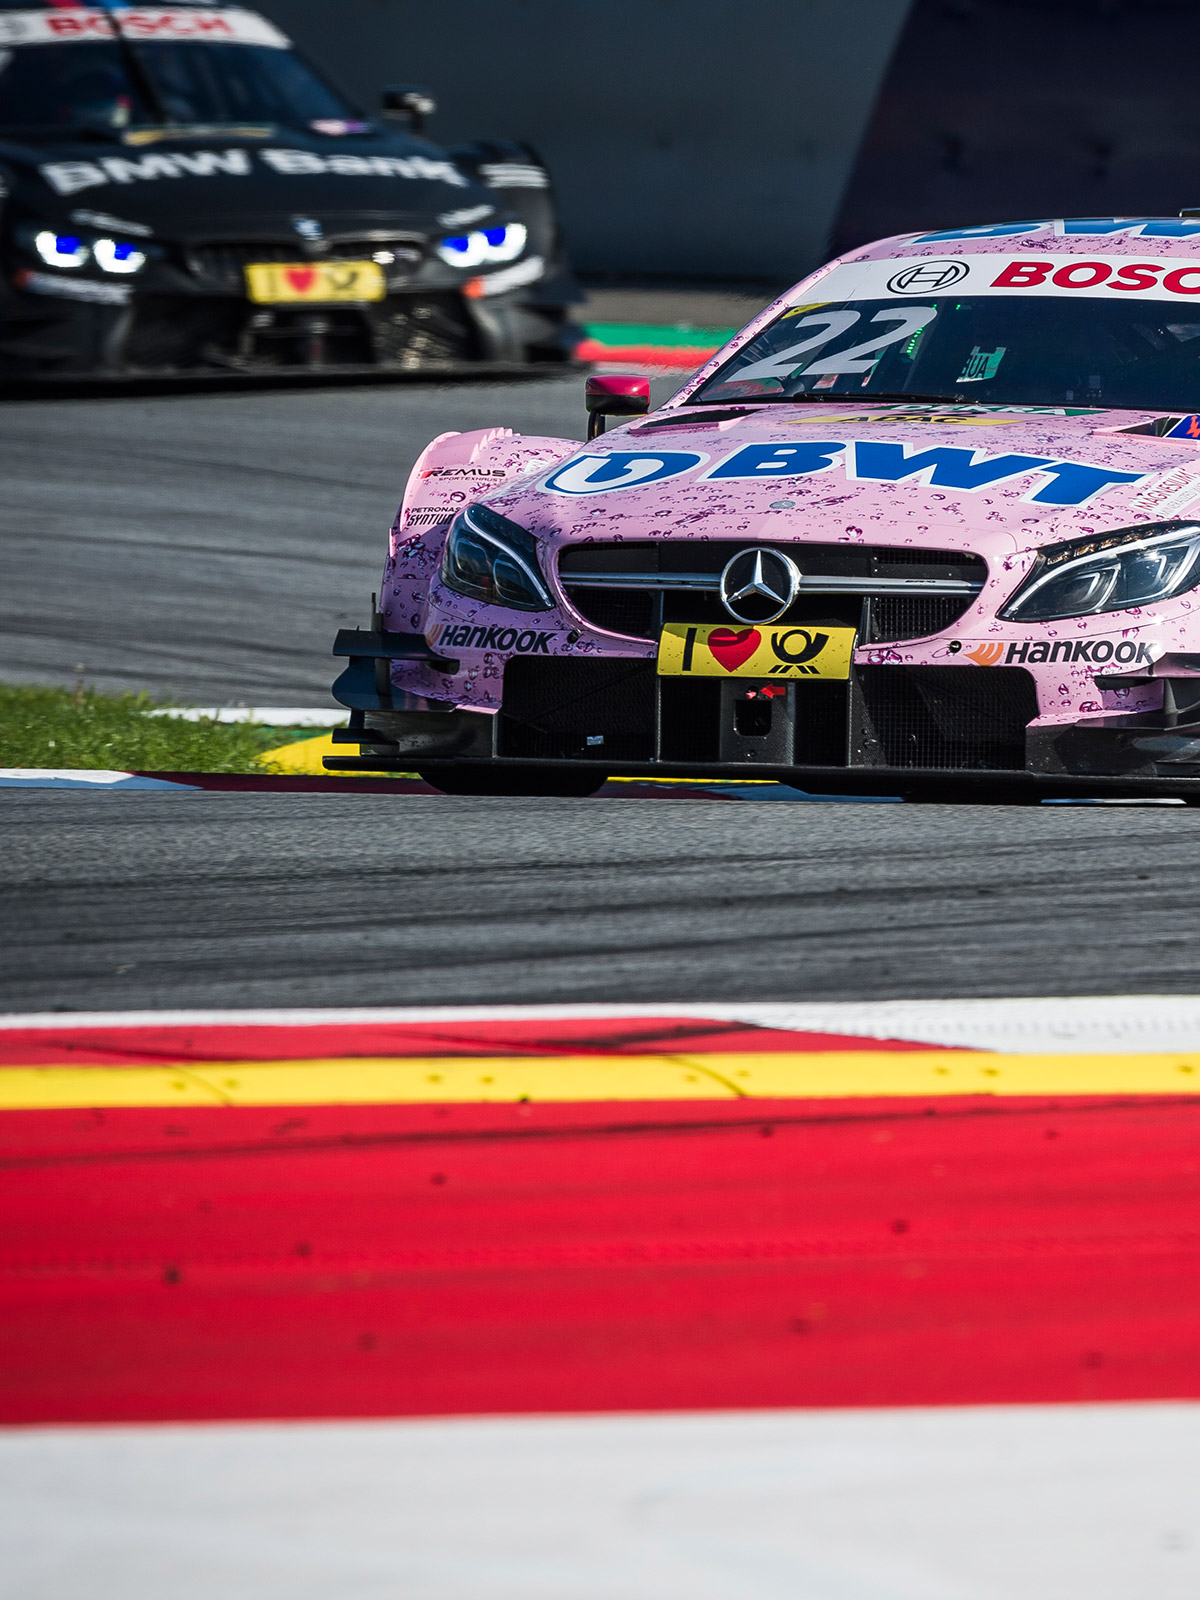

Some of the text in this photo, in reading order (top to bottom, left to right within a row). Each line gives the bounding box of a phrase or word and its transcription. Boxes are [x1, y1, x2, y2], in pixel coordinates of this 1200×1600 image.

[41, 149, 251, 195] BMW
[259, 149, 468, 188] Bank
[725, 306, 938, 383] 22
[427, 468, 506, 477] REMUS
[704, 440, 1156, 506] BWT
[682, 627, 698, 671] I
